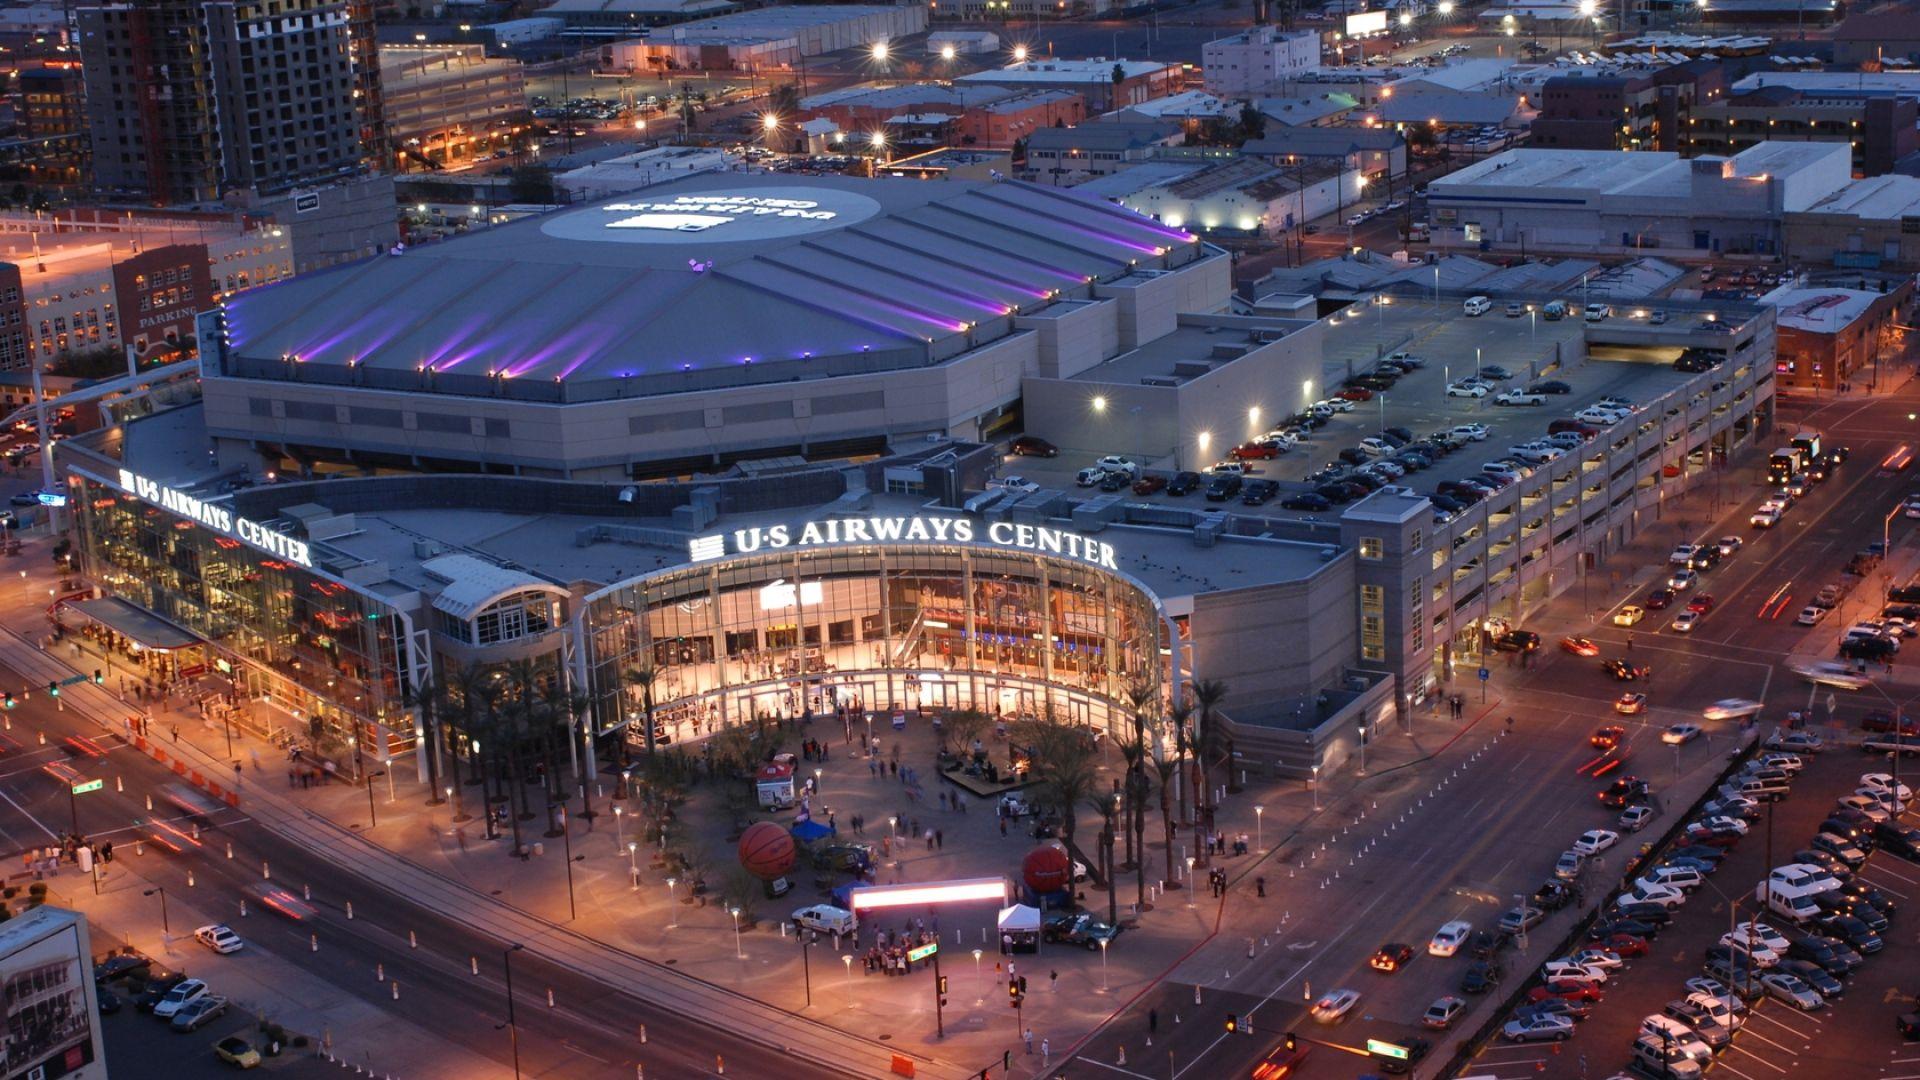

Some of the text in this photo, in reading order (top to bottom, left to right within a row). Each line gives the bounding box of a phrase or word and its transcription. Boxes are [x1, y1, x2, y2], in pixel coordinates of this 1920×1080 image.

[139, 306, 197, 328] PARKING
[161, 487, 232, 532] AIRWAYS
[237, 516, 313, 567] CENTER
[798, 517, 974, 545] AIRWAYS
[989, 522, 1119, 570] CENTER
